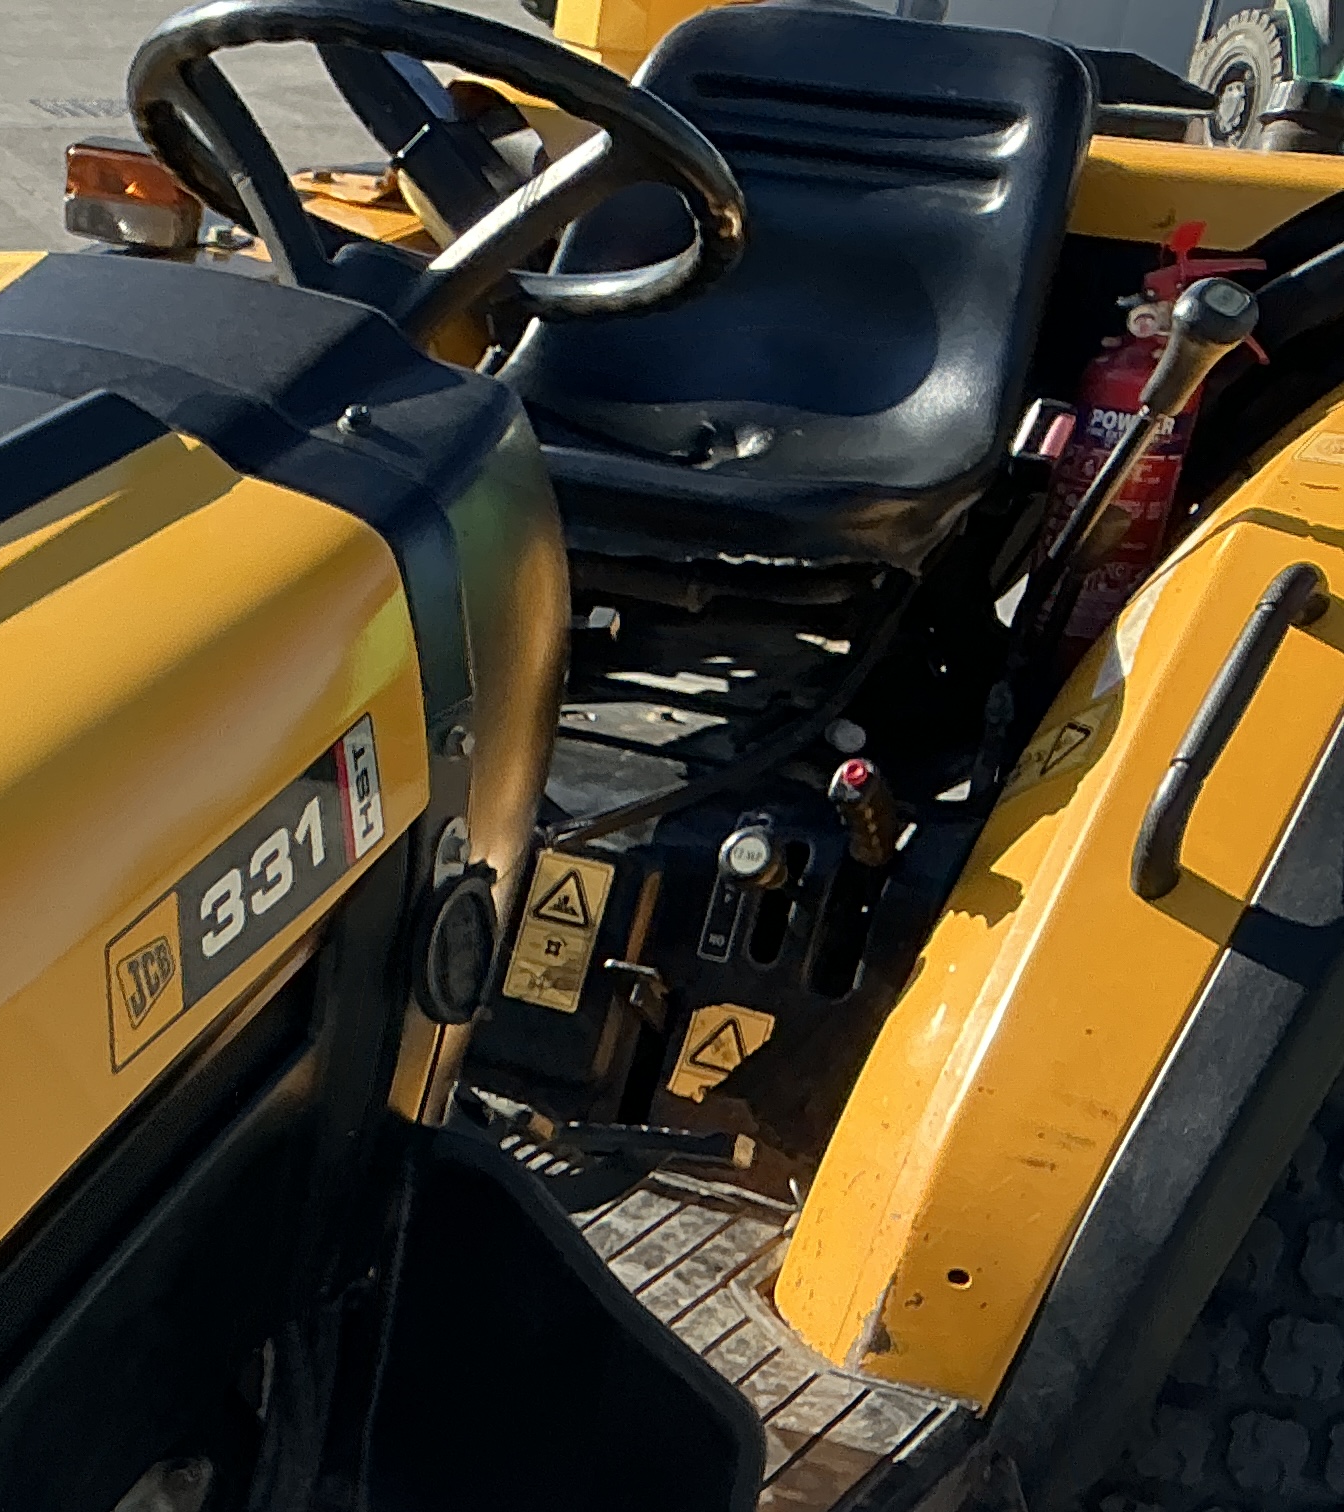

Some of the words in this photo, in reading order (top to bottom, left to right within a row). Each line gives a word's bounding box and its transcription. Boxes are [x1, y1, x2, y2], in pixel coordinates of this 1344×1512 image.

[1091, 408, 1175, 435] POWER
[350, 745, 374, 838] HST
[127, 943, 172, 1017] JCB
[200, 796, 326, 958] 331
